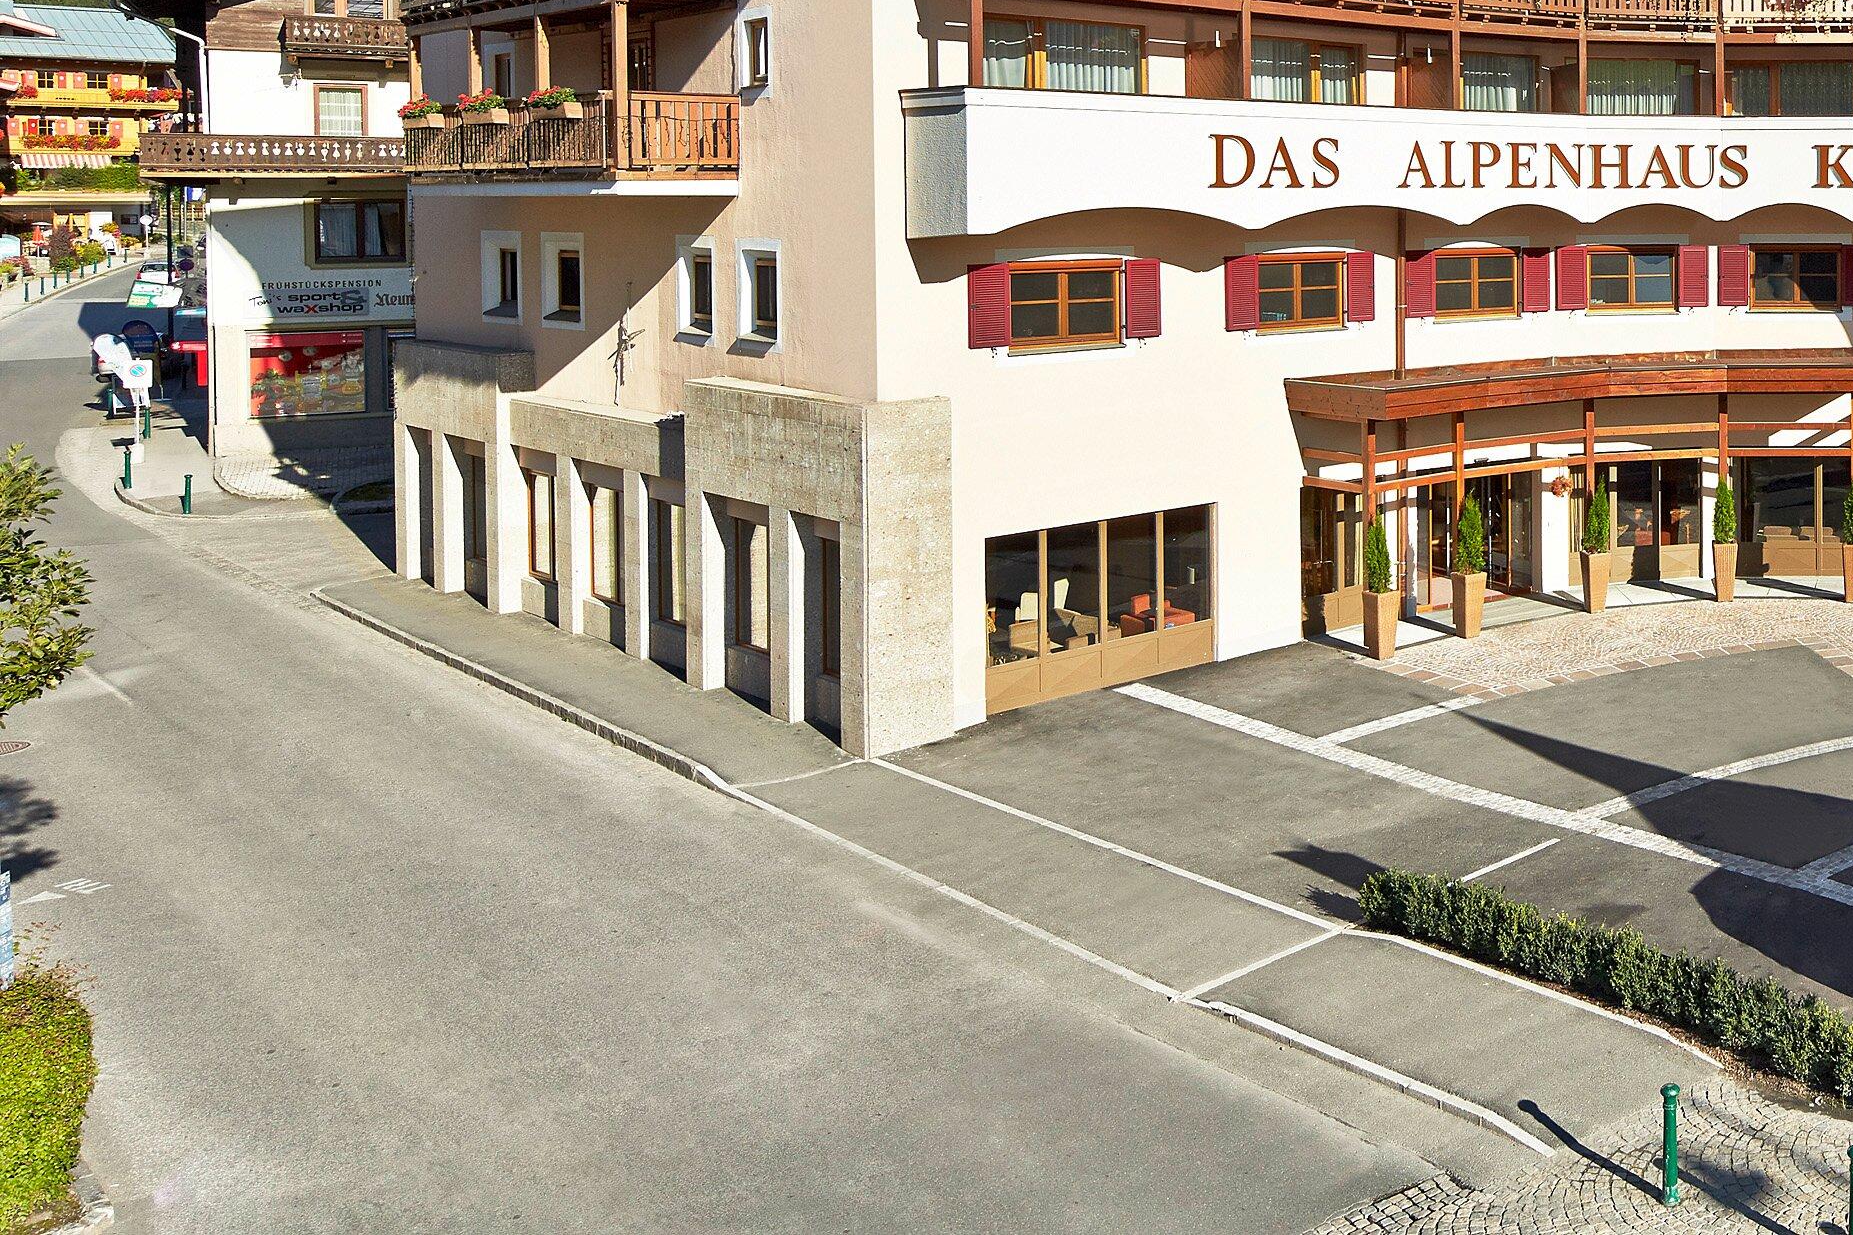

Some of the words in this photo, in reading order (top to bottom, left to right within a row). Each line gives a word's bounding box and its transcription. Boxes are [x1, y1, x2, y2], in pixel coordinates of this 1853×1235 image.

[1208, 133, 1341, 189] DAS
[1397, 140, 1750, 189] ALPENHAUS
[261, 279, 382, 290] FRÜHSTÜCKSPENSION
[288, 292, 341, 303] sport
